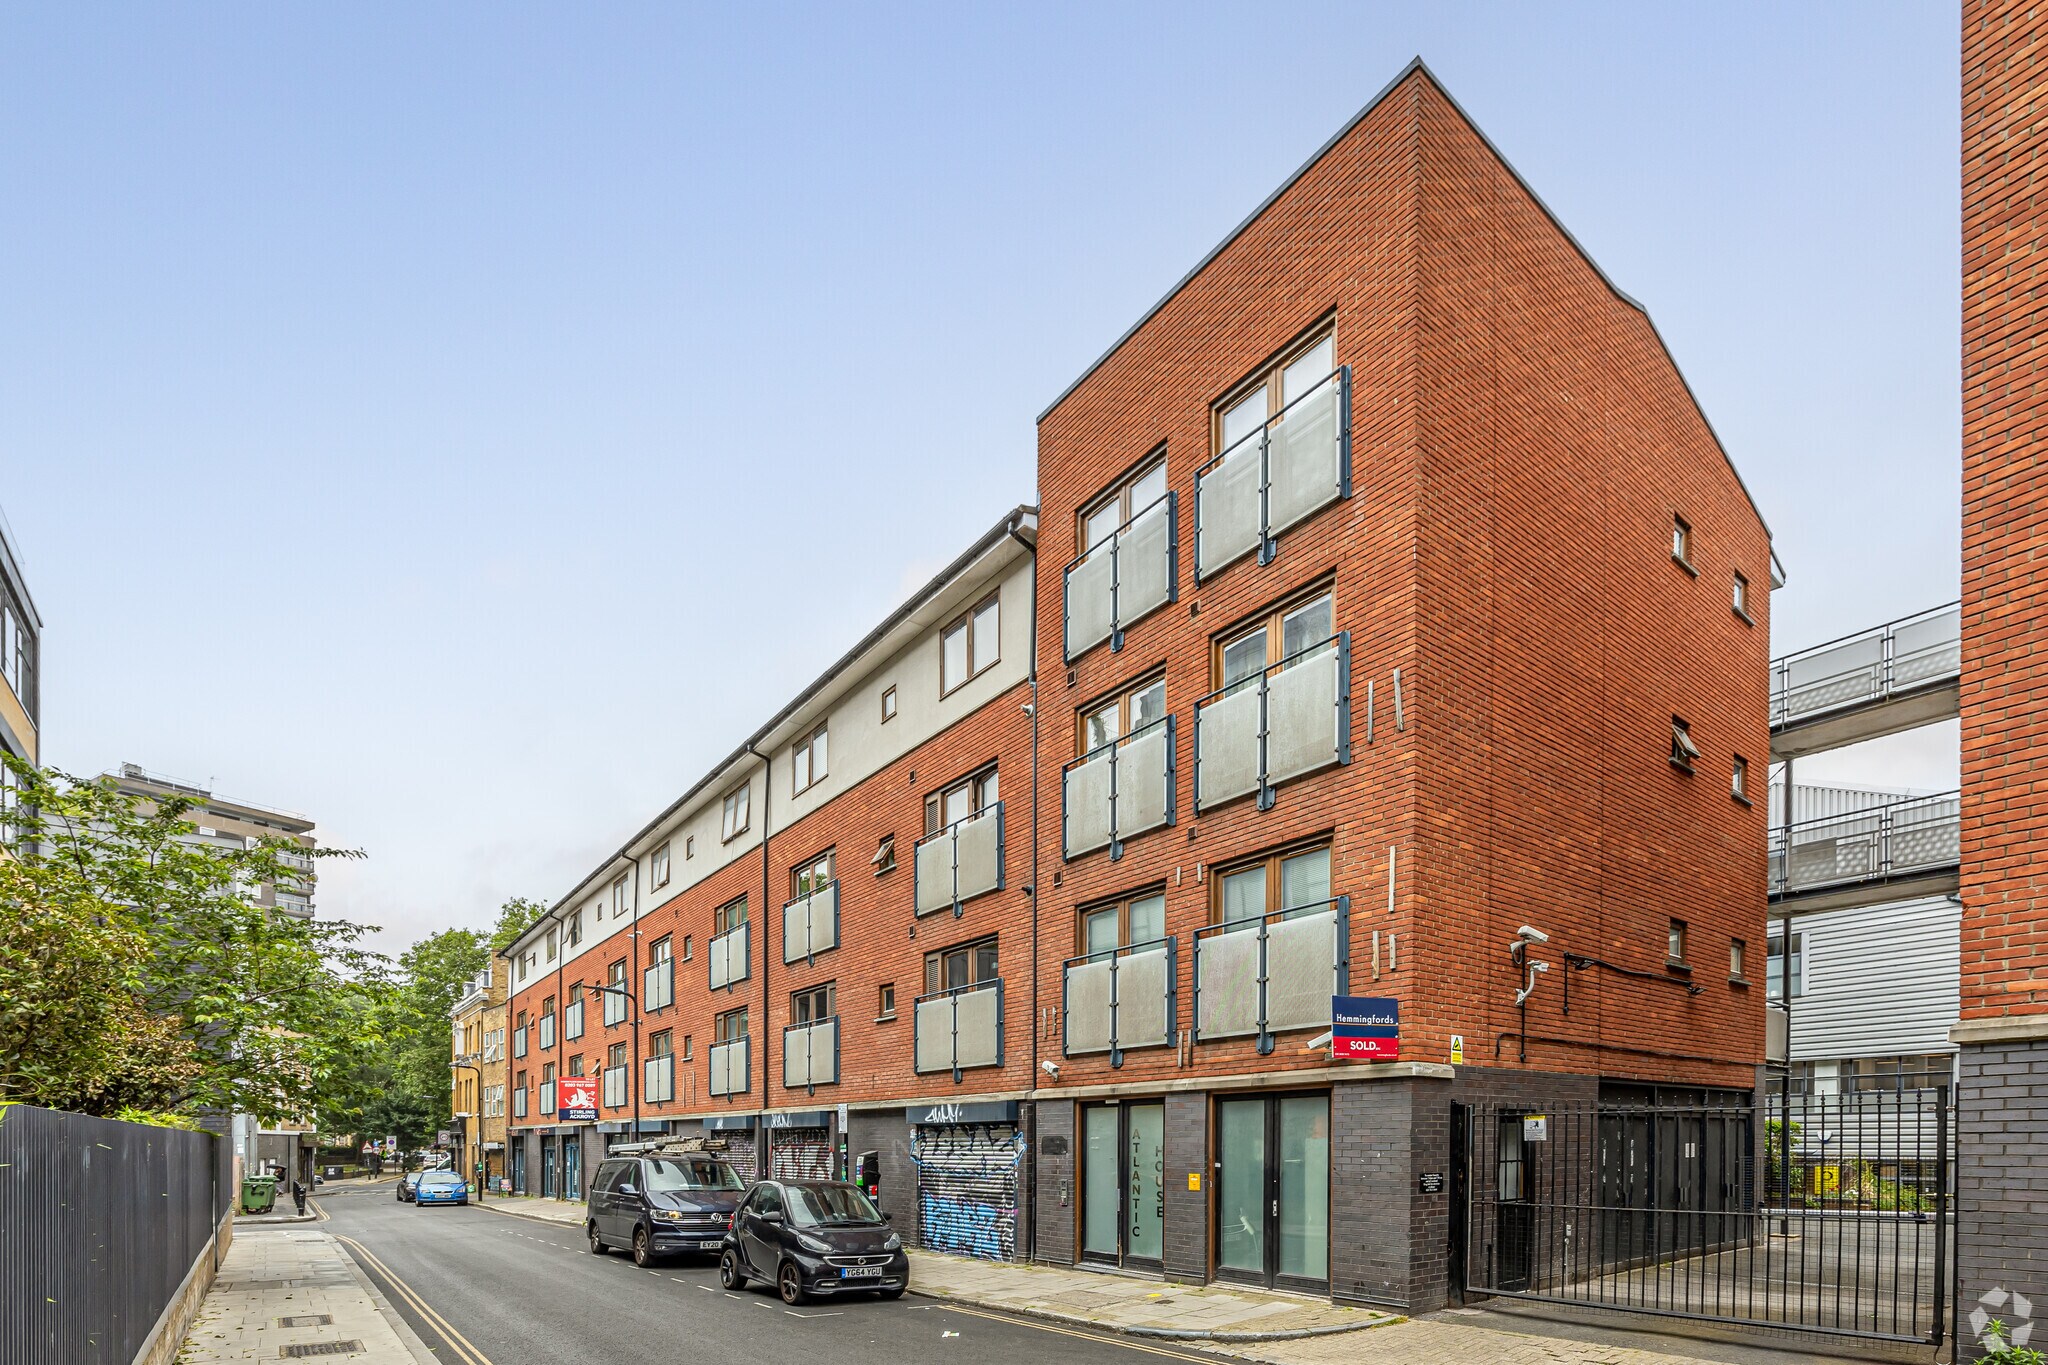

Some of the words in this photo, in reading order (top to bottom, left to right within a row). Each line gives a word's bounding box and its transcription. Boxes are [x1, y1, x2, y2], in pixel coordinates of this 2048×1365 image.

[1336, 1013, 1394, 1026] Hemmingfords
[1132, 1128, 1141, 1237] ATLANTIC
[846, 1268, 865, 1277] YG64
[866, 1267, 881, 1276] YGU
